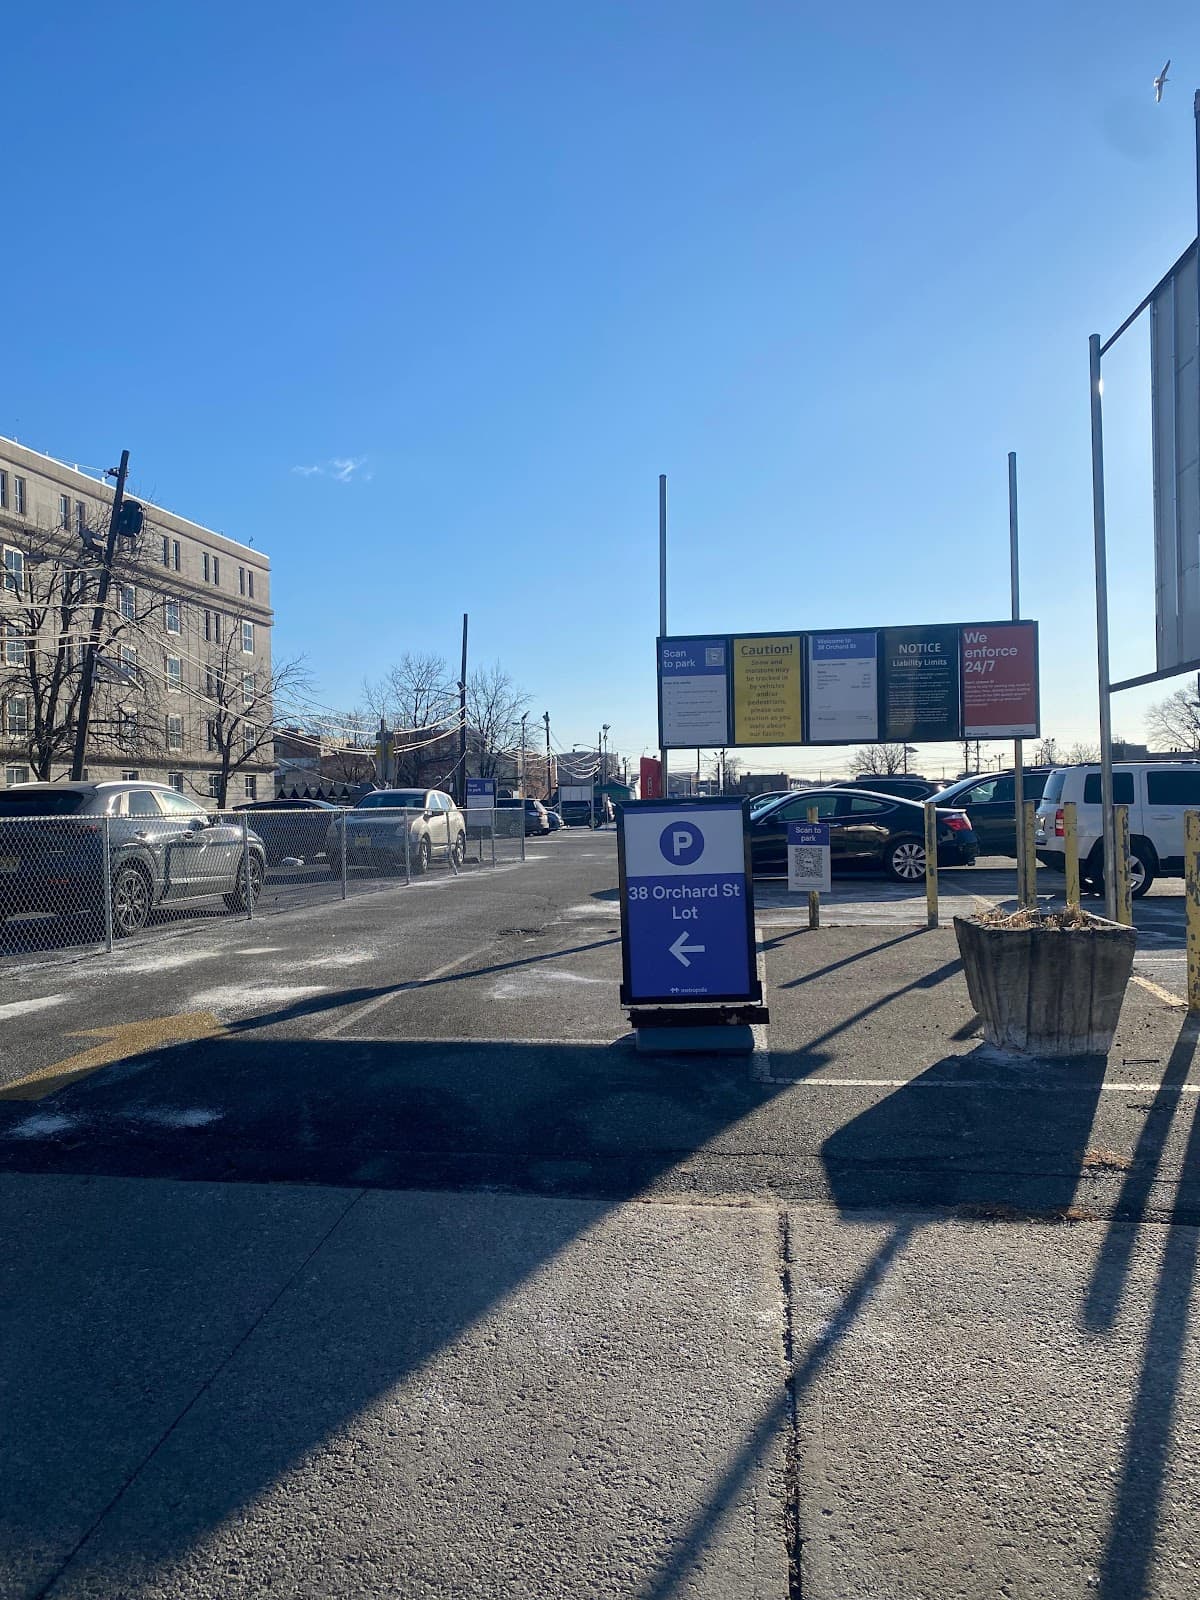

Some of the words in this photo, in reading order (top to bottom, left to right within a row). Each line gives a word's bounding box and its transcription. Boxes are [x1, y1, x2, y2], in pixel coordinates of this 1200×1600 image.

[964, 631, 988, 644] We
[663, 649, 687, 658] Scan
[741, 643, 793, 656] Caution!
[898, 642, 941, 654] NOTICE
[964, 646, 1018, 658] enforce
[663, 660, 674, 668] to
[675, 659, 696, 670] park
[892, 658, 923, 668] Liability
[924, 657, 948, 666] Limits
[965, 659, 995, 675] 24/7
[795, 826, 813, 834] Scan
[814, 826, 821, 834] to
[672, 831, 693, 857] P
[801, 834, 817, 844] park
[628, 886, 649, 900] 38
[653, 883, 718, 900] Orchard
[722, 882, 741, 897] St
[672, 905, 699, 920] Lot
